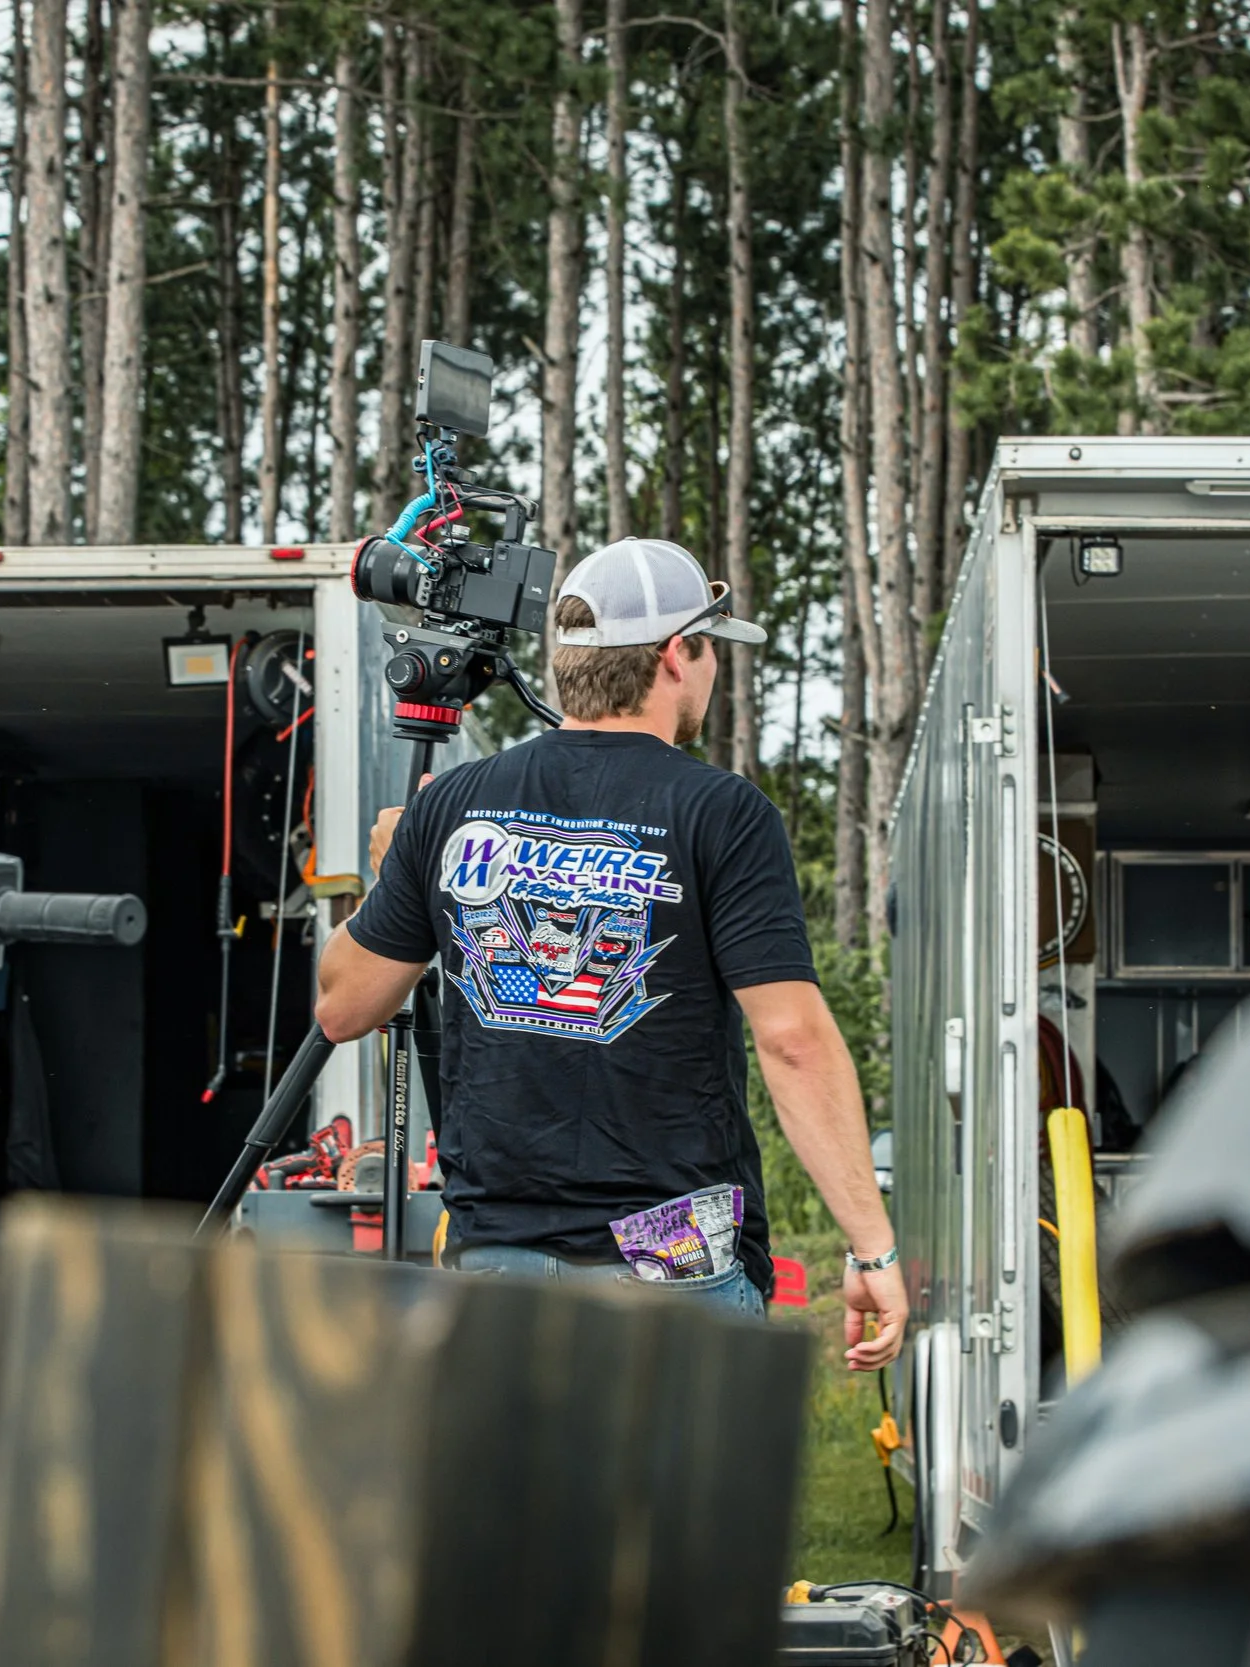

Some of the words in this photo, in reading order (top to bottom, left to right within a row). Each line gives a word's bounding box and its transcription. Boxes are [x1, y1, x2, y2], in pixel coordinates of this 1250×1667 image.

[465, 810, 516, 819] AMERICAN
[520, 811, 548, 823] MADE
[551, 817, 604, 829] INNOVATION
[607, 821, 638, 833] SINCE
[641, 826, 668, 837] 1997
[517, 840, 664, 880] WEHRS
[500, 864, 680, 899] MACHINE
[394, 1049, 408, 1126] Manfrotto
[669, 1238, 702, 1257] DOUBLE
[673, 1249, 705, 1267] FLAVORED
